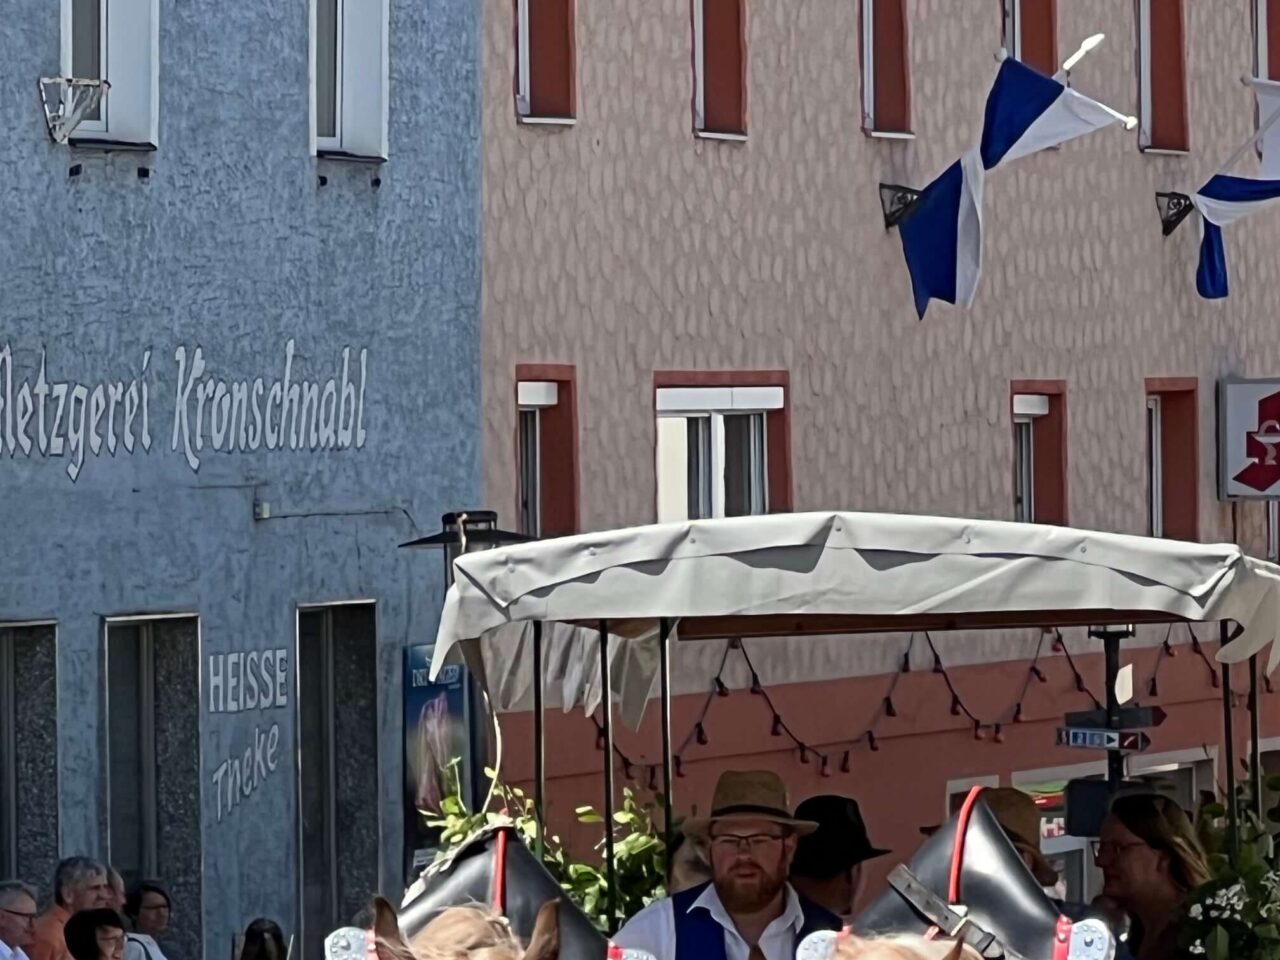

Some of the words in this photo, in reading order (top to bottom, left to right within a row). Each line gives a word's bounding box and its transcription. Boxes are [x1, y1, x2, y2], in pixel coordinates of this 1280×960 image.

[172, 338, 367, 473] Kronschnabl
[209, 649, 288, 712] HEISSE
[212, 724, 279, 823] Theke
